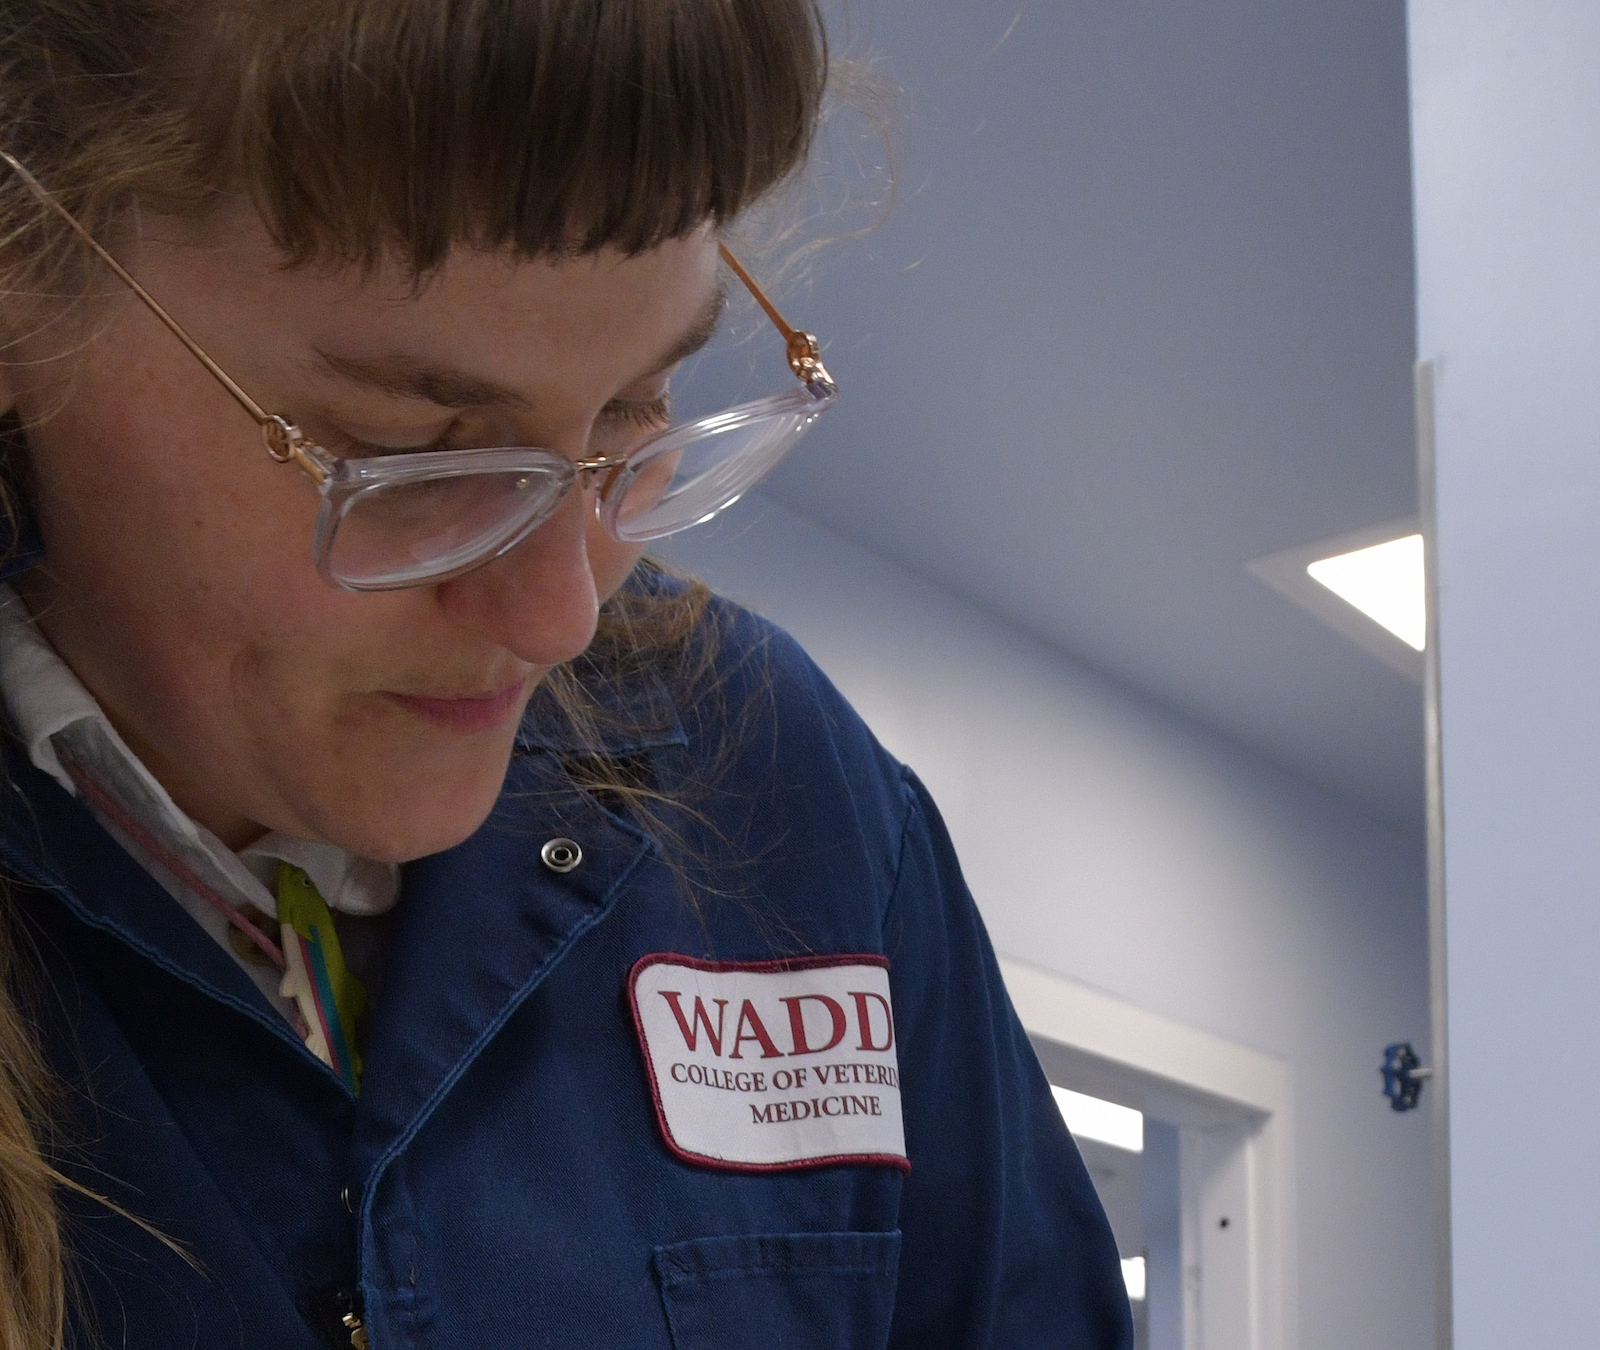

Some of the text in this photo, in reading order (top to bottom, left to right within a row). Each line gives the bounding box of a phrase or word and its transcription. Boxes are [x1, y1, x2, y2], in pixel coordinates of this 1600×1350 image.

[657, 990, 893, 1060] WADD
[670, 1062, 768, 1092] COLLEGE
[771, 1068, 807, 1092] OF
[748, 1095, 883, 1124] MEDICINE
